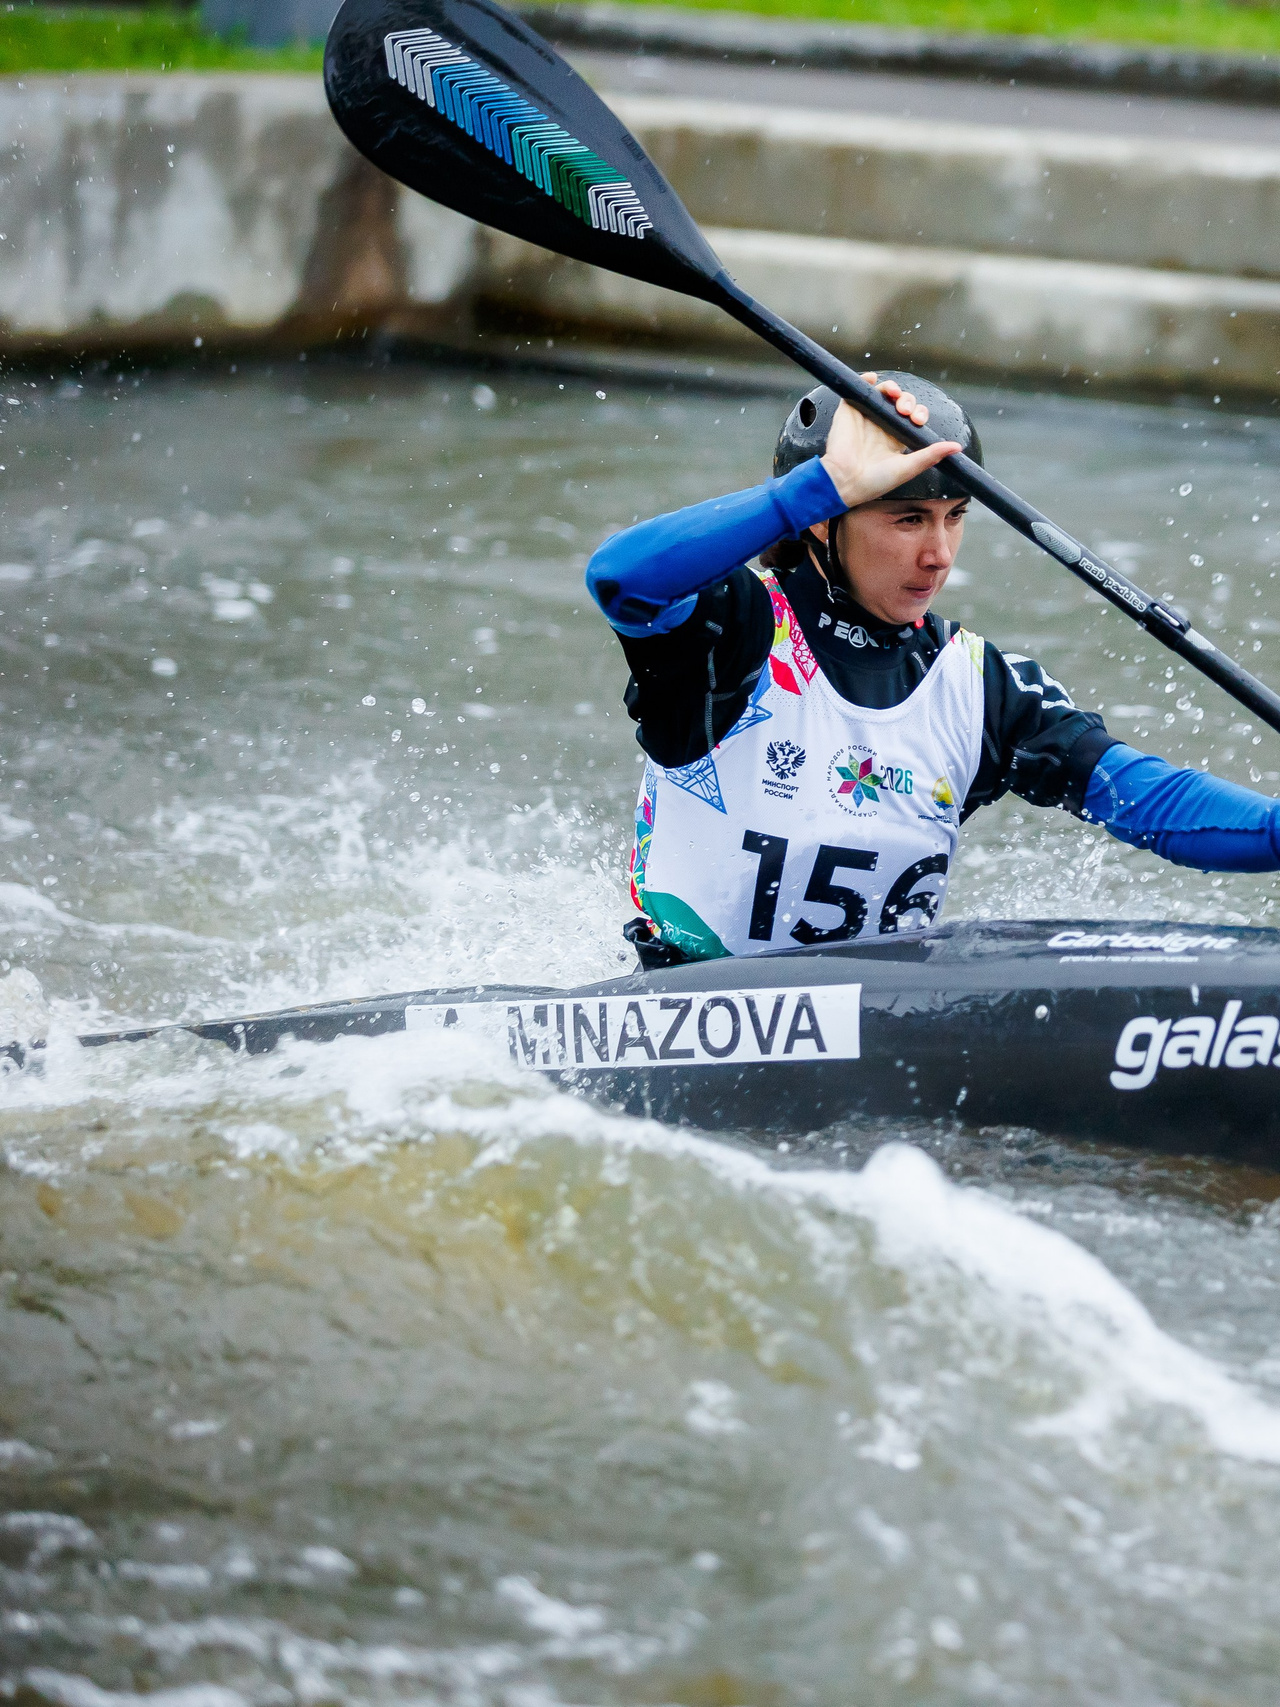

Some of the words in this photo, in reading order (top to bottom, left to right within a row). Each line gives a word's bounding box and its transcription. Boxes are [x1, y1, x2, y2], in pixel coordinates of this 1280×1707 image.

[1079, 557, 1107, 581] raab
[1103, 577, 1146, 613] paddles
[827, 748, 844, 782] НАРОДОВ
[848, 744, 878, 757] РОССИИ
[762, 778, 799, 793] МИНСПОРТ
[764, 788, 793, 800] РОССИИ
[742, 829, 949, 945] 156
[1047, 931, 1238, 953] Carbolight
[508, 992, 827, 1065] MINAZOVA
